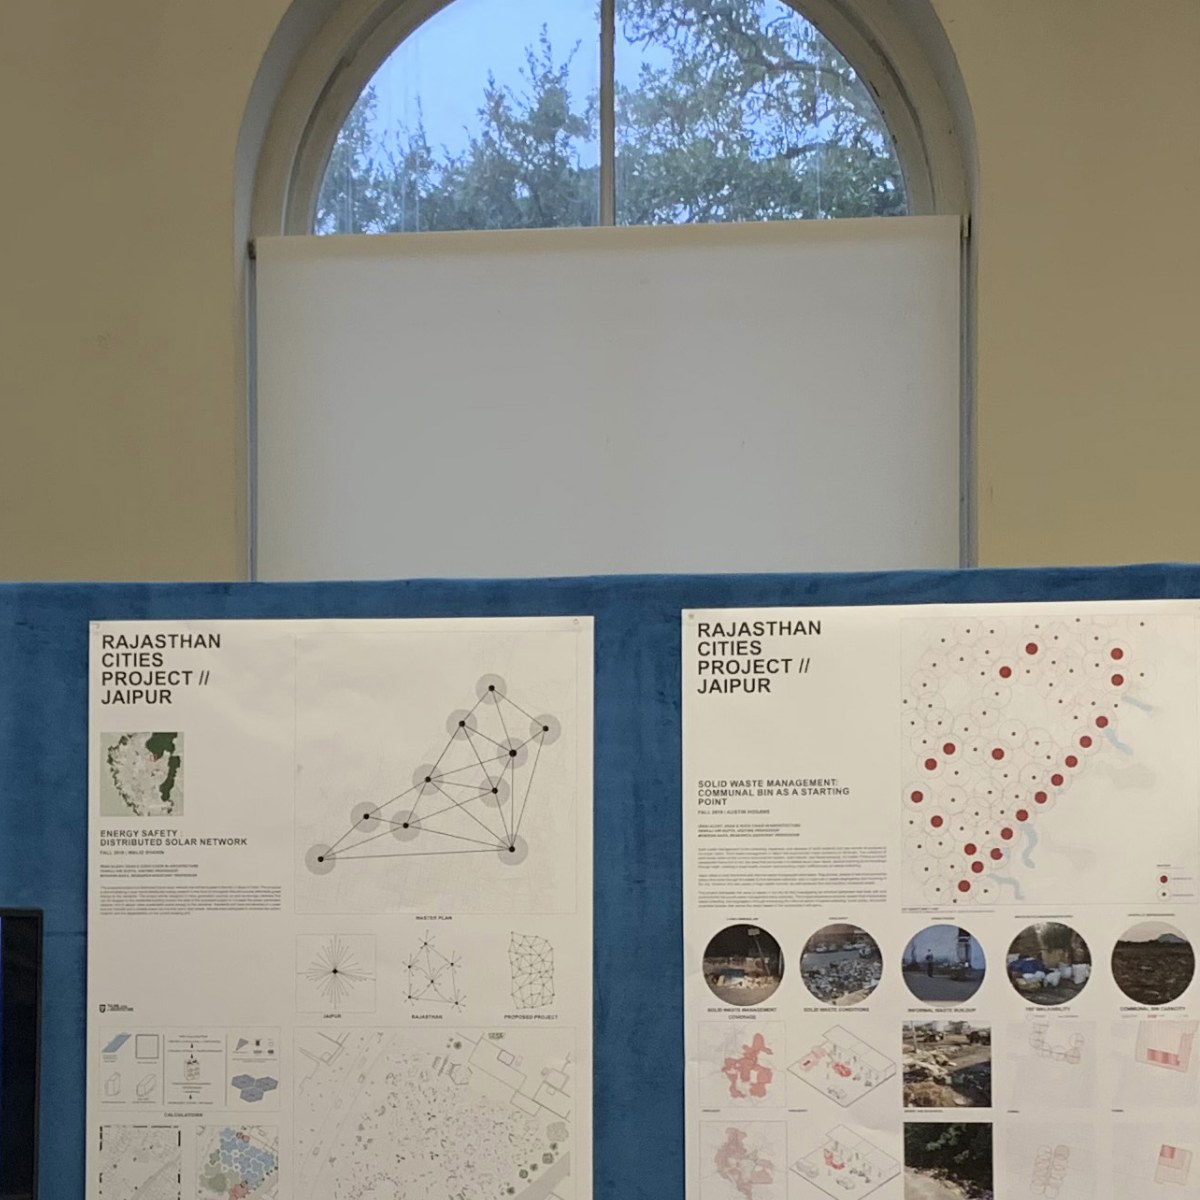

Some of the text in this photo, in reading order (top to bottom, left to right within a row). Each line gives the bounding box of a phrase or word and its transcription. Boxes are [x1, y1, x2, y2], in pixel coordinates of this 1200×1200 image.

[698, 620, 822, 638] RAJASTHAN
[102, 633, 221, 650] RAJASTHAN
[697, 640, 762, 656] CITIES
[101, 652, 164, 668] CITIES
[698, 658, 810, 675] PROJECT //
[102, 670, 210, 686] PROJECT //
[697, 678, 771, 694] JAIPUR
[101, 689, 172, 705] JAIPUR
[698, 778, 838, 788] SOLID WASTE MANAGEMENT:
[698, 787, 850, 797] COMMUNAL BIN AS A STARTING
[698, 798, 727, 806] POINT
[100, 829, 138, 838] ENERGY
[100, 838, 247, 847] DISTRIBUTED SOLAR NETWORK
